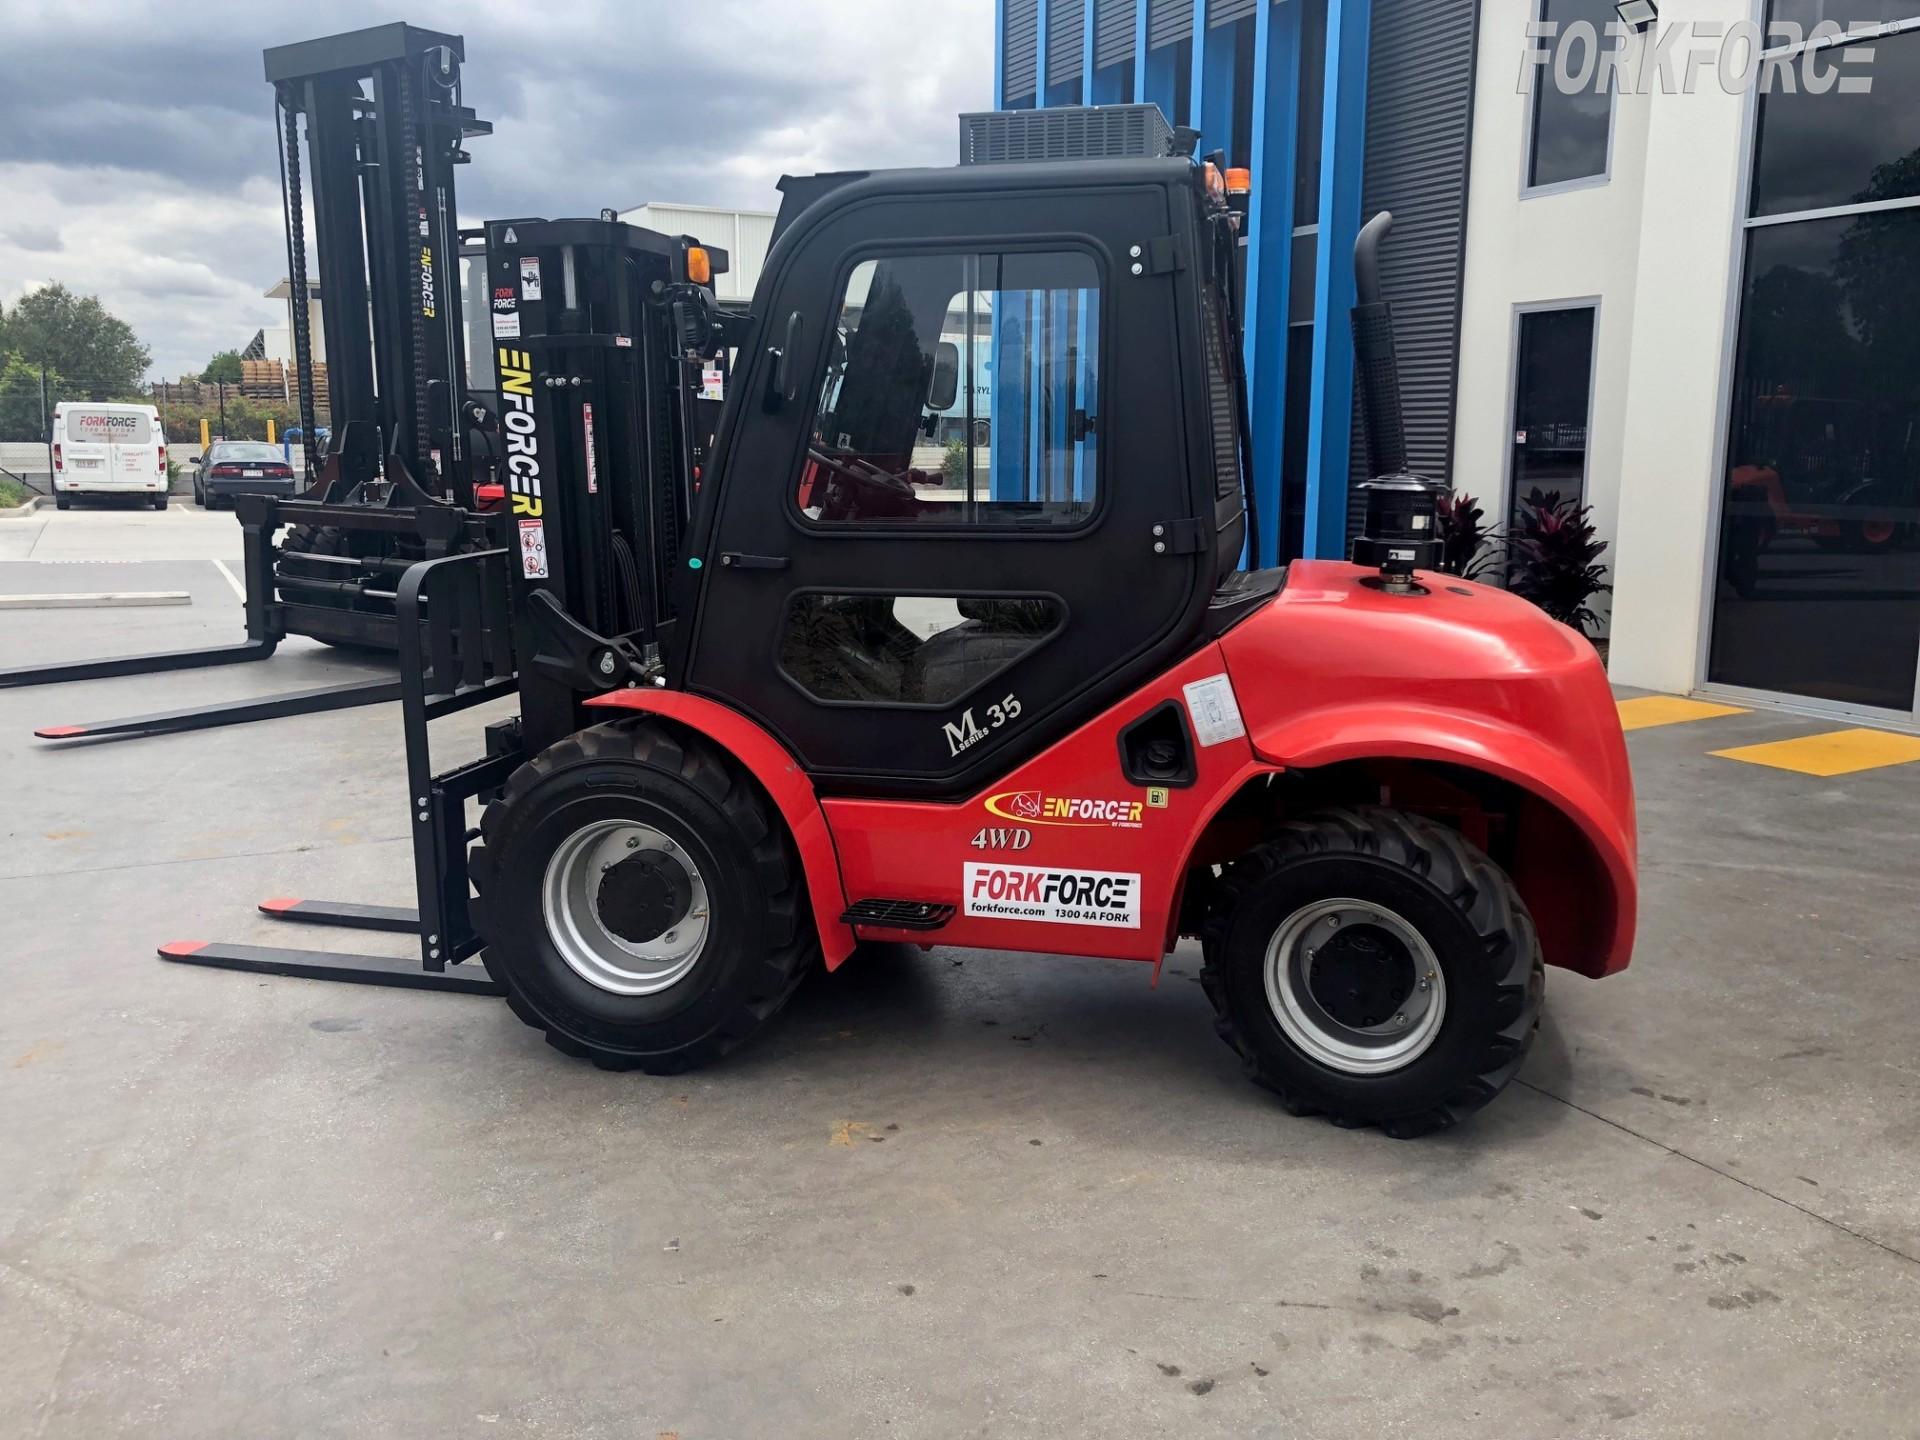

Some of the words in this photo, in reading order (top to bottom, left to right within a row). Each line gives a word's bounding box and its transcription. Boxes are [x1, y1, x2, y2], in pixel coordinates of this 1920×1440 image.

[421, 246, 435, 318] ENFORCER
[495, 287, 514, 298] FORK
[493, 298, 516, 309] FORCE
[80, 416, 137, 428] FORKFORCE
[499, 347, 543, 518] ENFORCER
[941, 706, 980, 757] M
[986, 692, 1022, 728] 35
[958, 727, 989, 751] SERIES
[1042, 797, 1144, 822] ENFORCER
[970, 827, 1033, 850] 4WD
[972, 868, 1131, 909] FORKFORCE
[971, 902, 1046, 917] forkforce.com
[1055, 908, 1081, 919] 1300
[1082, 910, 1097, 921] 4A
[1099, 911, 1130, 923] FORK
